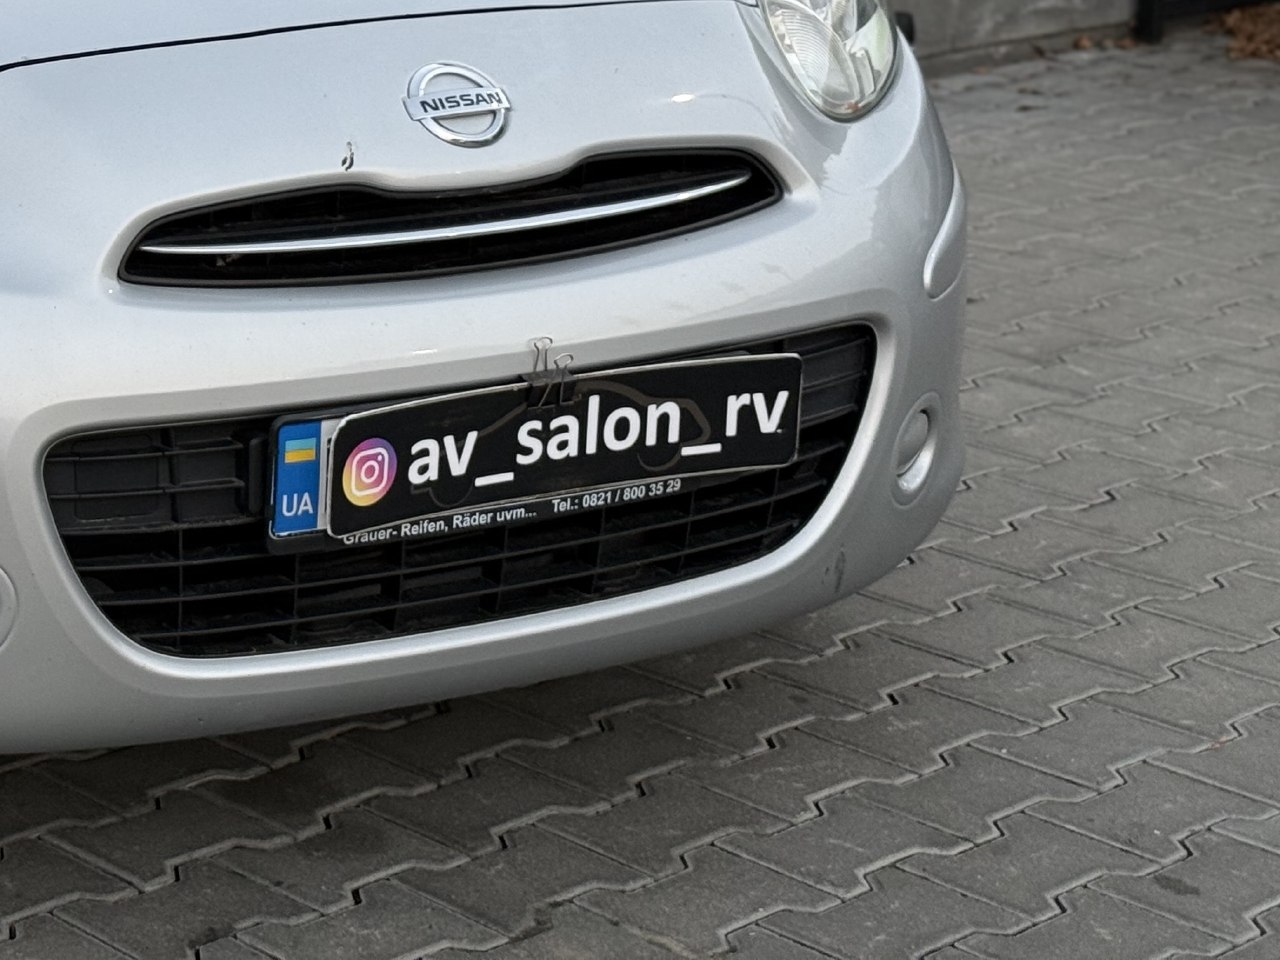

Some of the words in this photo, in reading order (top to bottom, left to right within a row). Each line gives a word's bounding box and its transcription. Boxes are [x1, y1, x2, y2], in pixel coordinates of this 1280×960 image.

[419, 91, 504, 114] NISSAN
[406, 390, 790, 489] av_salon_rv
[282, 492, 314, 518] UA
[400, 519, 449, 537] Reifen,
[452, 512, 492, 528] Räder
[582, 491, 613, 508] 0821
[622, 485, 646, 501] 800
[648, 481, 665, 496] 35
[665, 477, 682, 493] 29
